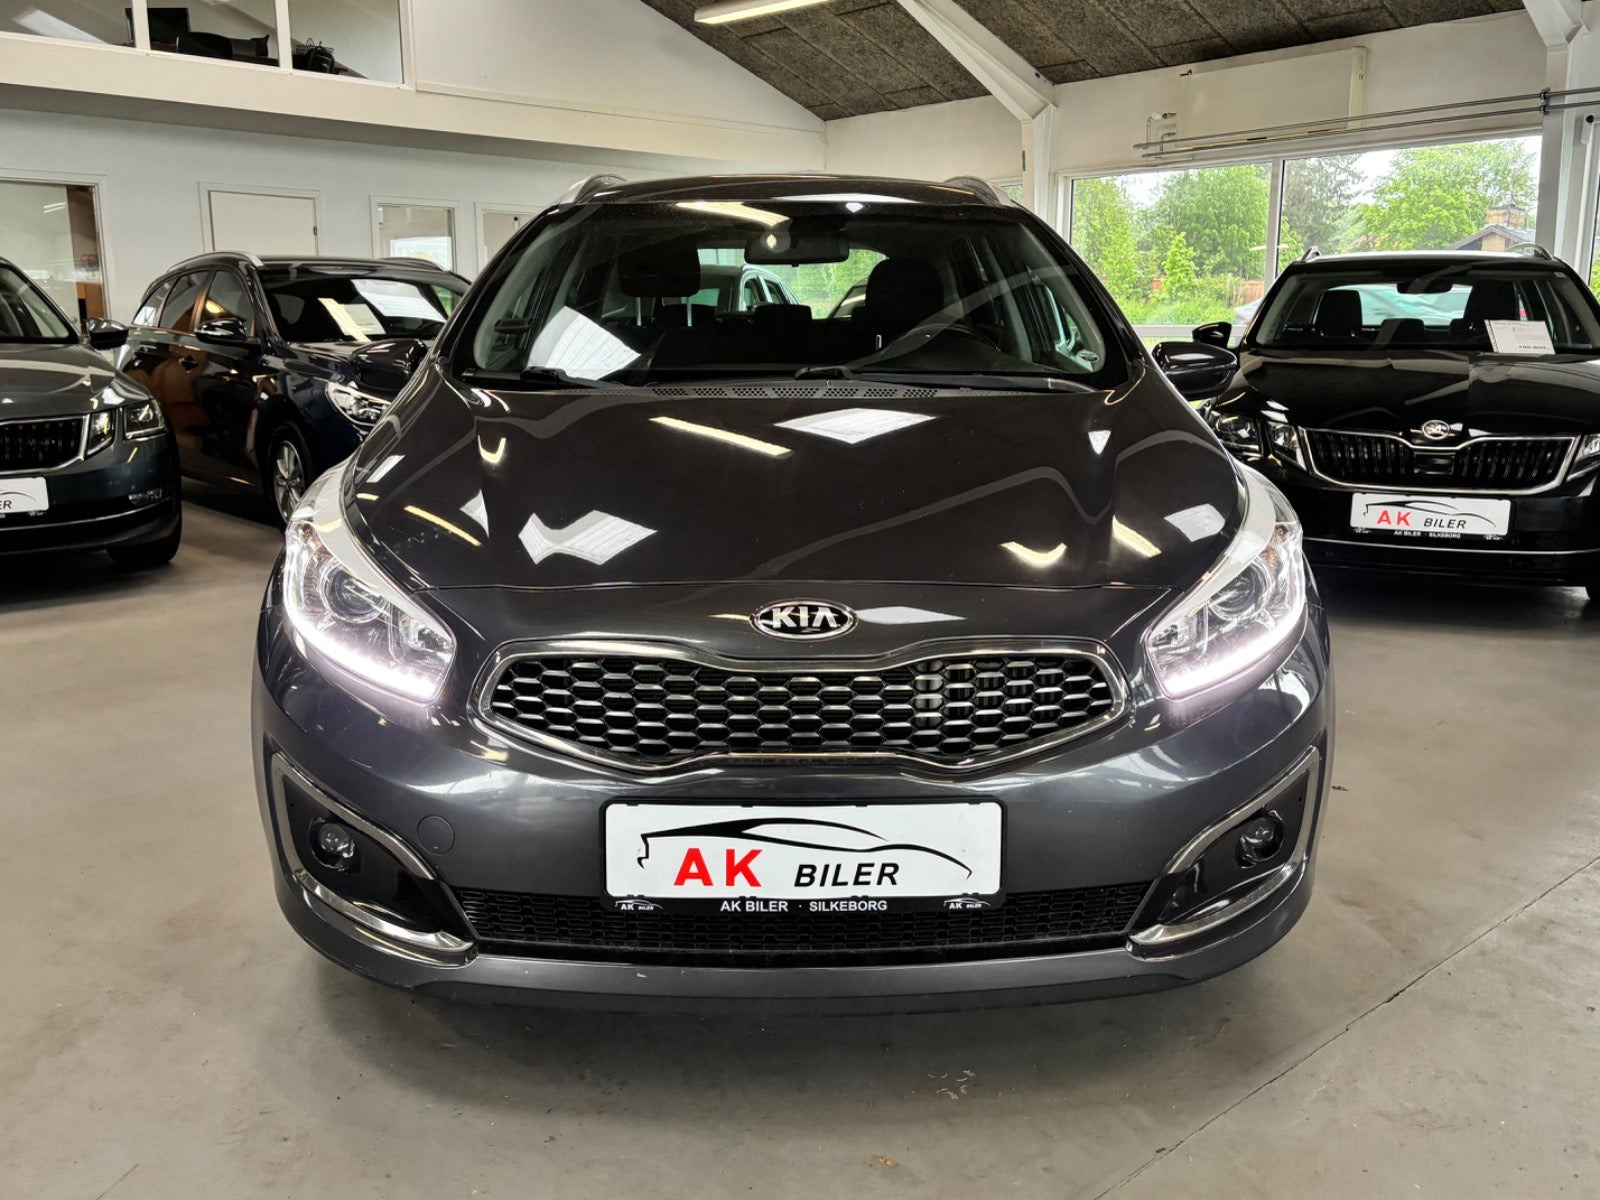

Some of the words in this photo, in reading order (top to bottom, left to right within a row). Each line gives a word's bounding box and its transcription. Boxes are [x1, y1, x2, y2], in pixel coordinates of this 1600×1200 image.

[1376, 509, 1413, 527] AK
[1423, 517, 1467, 529] BILER
[772, 605, 838, 628] KIA
[673, 847, 764, 888] AK
[793, 862, 900, 888] BILER
[720, 900, 741, 912] AK
[745, 900, 788, 912] BILER
[808, 900, 888, 911] SILKEBORG
